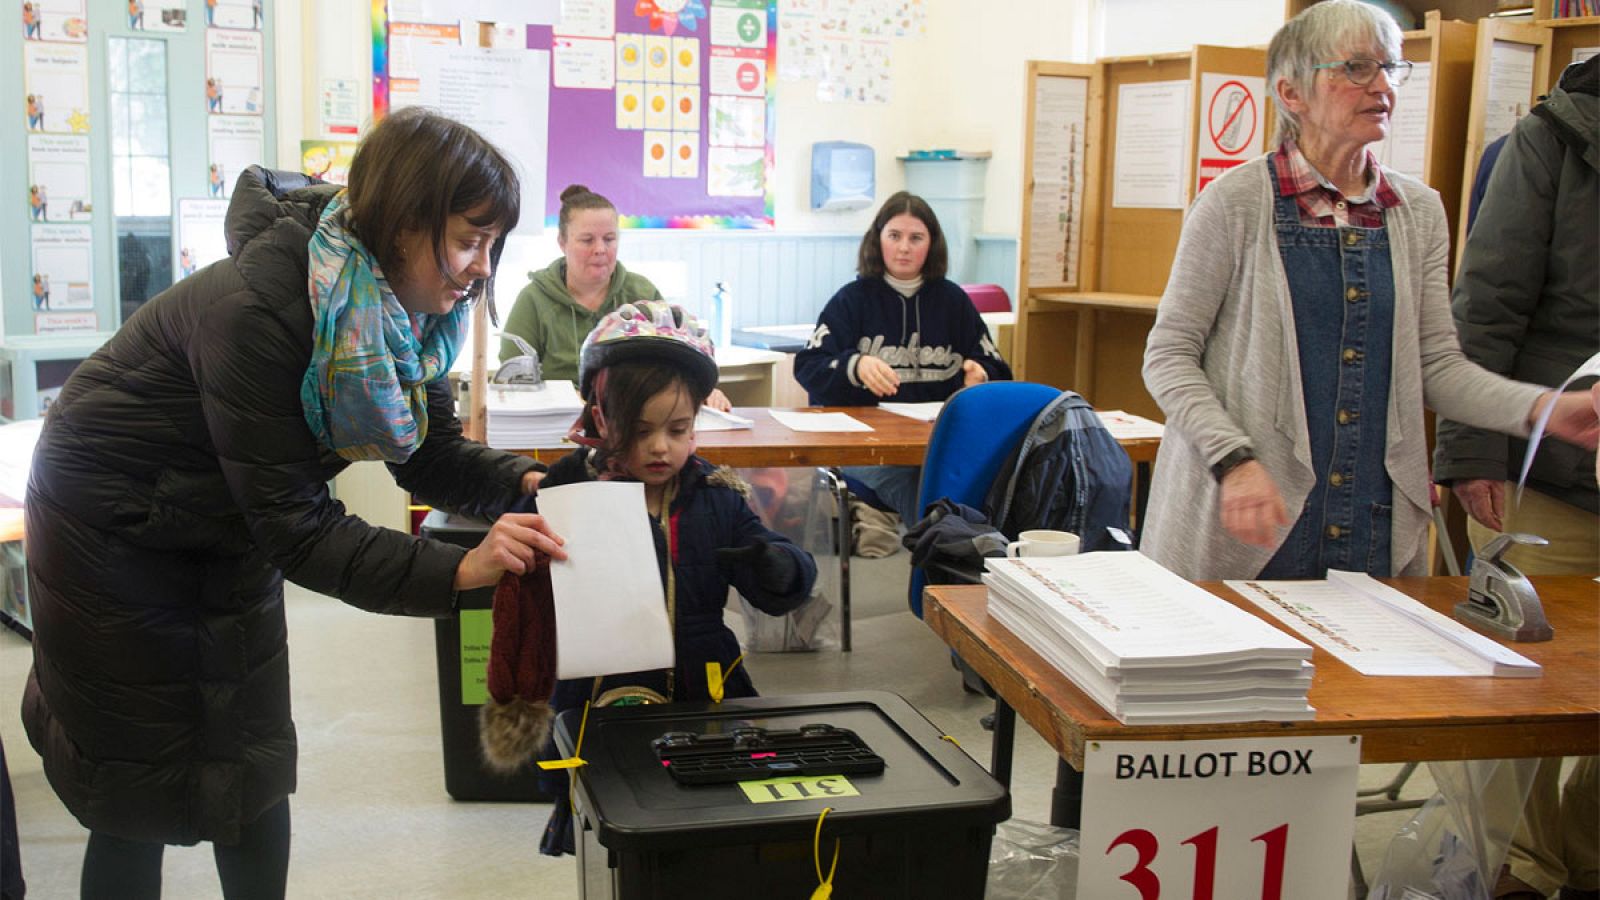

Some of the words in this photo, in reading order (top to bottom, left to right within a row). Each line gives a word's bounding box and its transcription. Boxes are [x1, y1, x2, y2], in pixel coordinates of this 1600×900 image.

[1115, 751, 1238, 780] BALLOT
[1247, 749, 1313, 777] BOX
[760, 778, 846, 801] 311
[1105, 823, 1289, 900] 311
